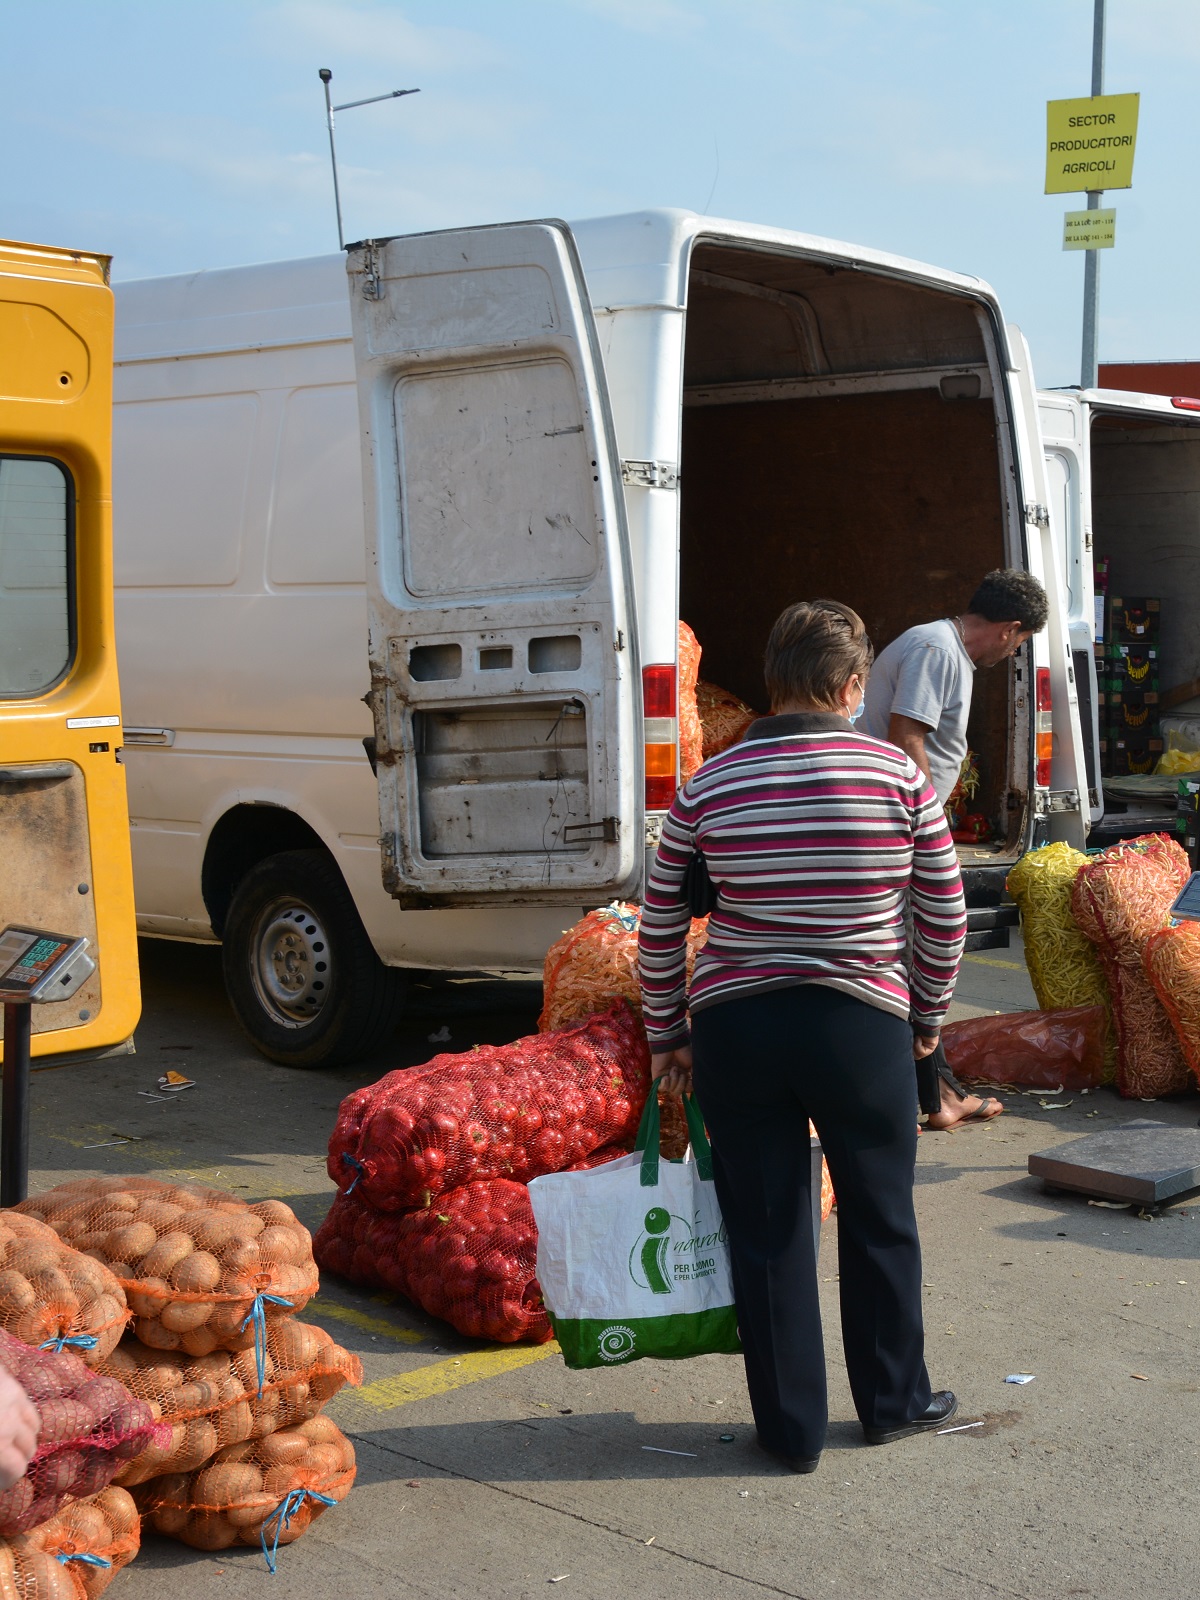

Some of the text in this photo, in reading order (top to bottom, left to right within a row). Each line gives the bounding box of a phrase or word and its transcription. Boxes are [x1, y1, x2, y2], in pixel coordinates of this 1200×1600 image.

[1068, 113, 1116, 128] SECTOR
[1050, 135, 1133, 152] PRODUCATORI
[1062, 160, 1116, 174] AGRICOLI
[674, 1264, 690, 1273] PER
